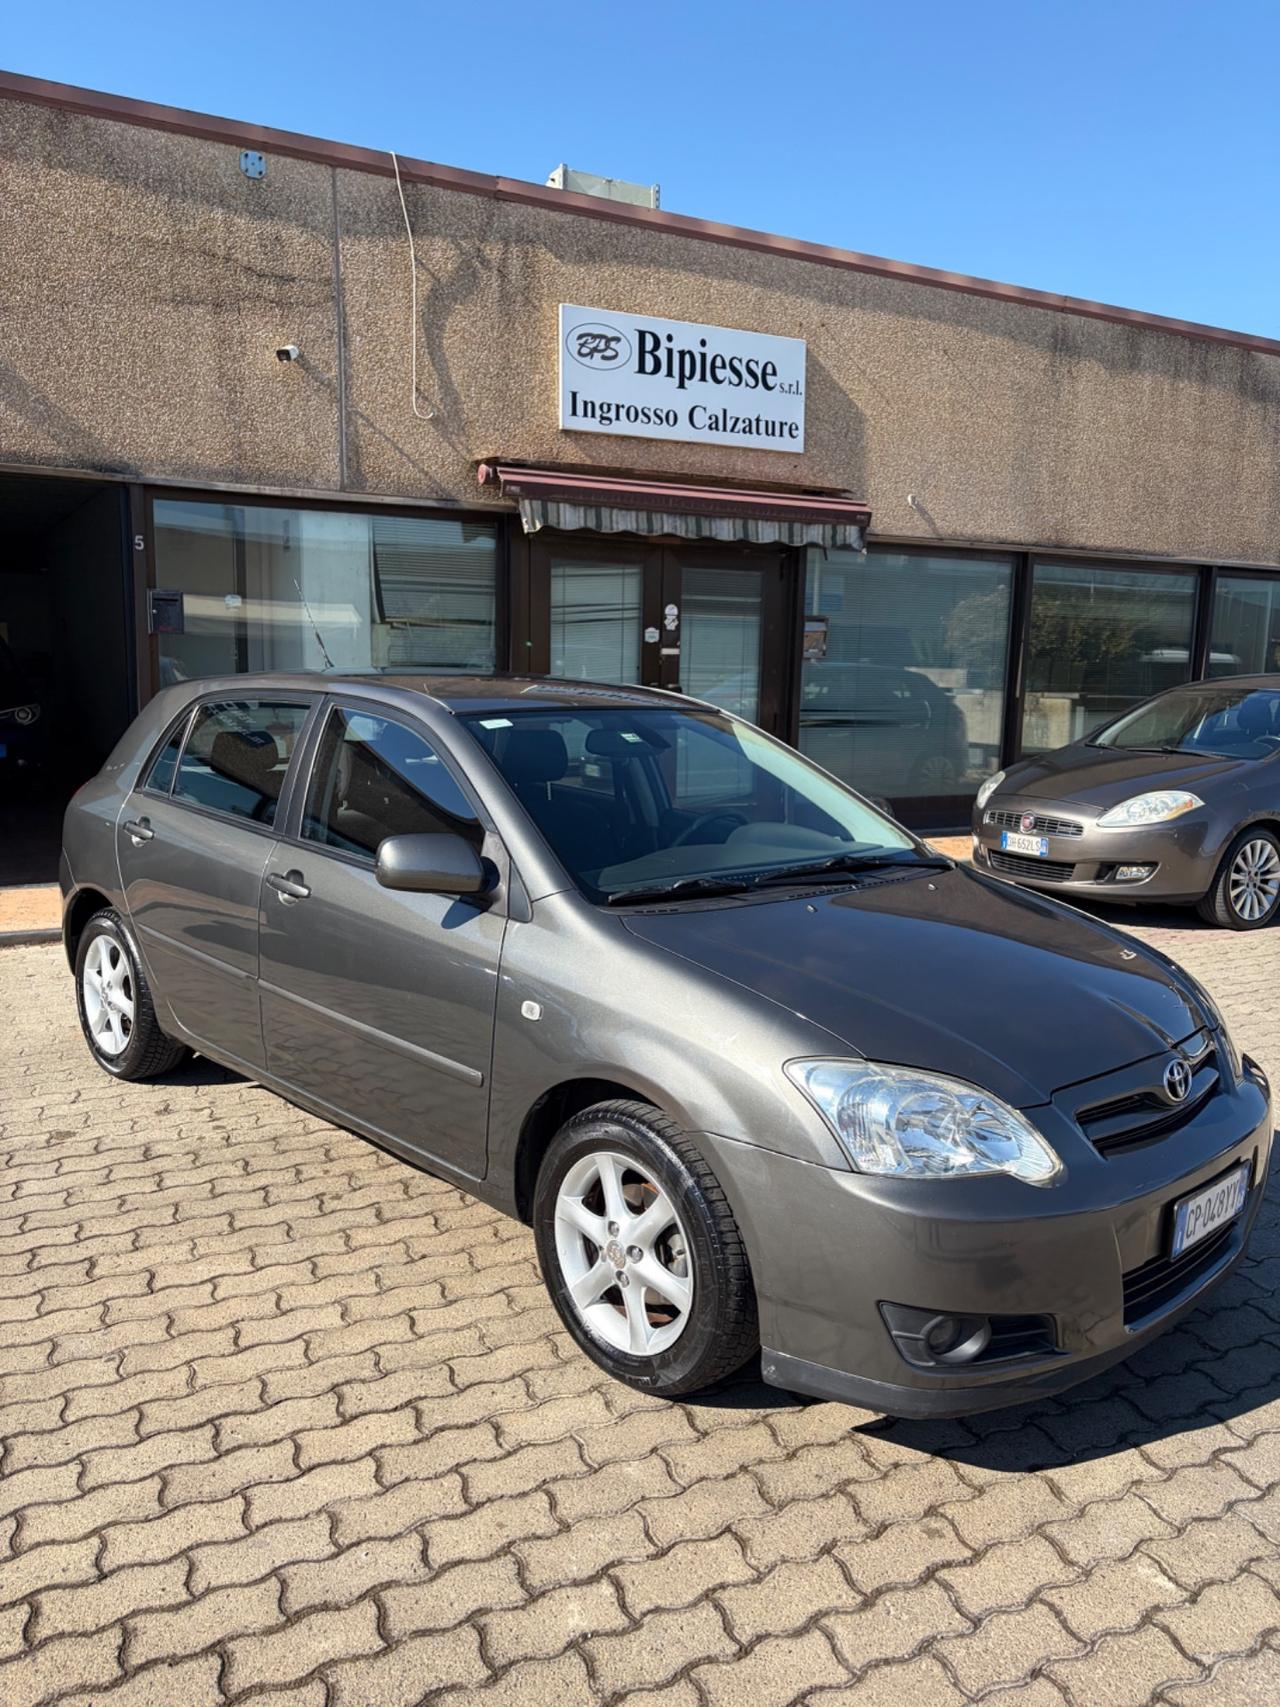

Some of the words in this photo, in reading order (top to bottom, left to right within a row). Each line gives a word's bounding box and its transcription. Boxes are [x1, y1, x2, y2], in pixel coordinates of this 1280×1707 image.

[634, 329, 778, 391] Bipiesse
[779, 380, 803, 396] s.r.l.
[569, 391, 678, 427] Ingrosso
[688, 405, 799, 439] Calzature
[135, 535, 144, 550] 5
